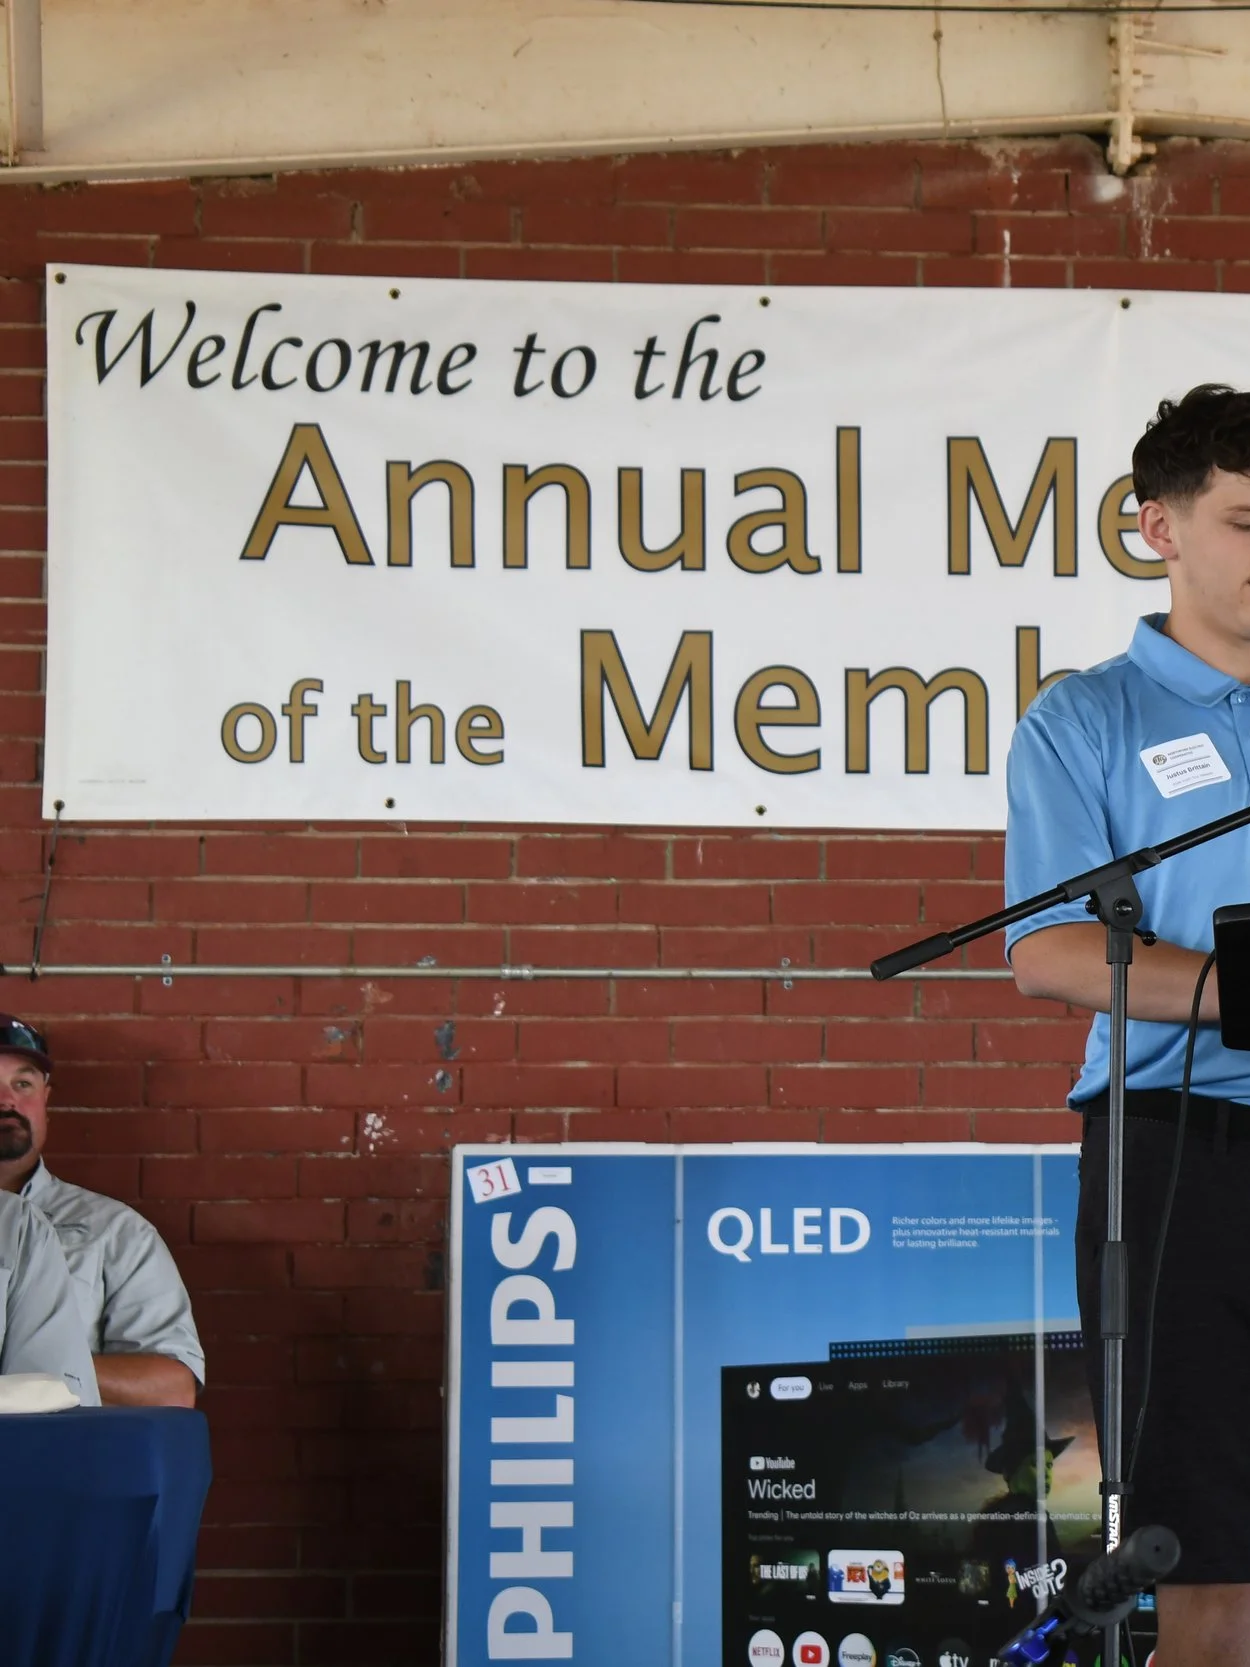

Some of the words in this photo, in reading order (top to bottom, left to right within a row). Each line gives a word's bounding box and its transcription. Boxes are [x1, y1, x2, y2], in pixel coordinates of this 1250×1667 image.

[75, 300, 478, 397] Welcome
[513, 331, 597, 400] to
[633, 313, 767, 402] the
[238, 421, 863, 576] Annual
[220, 677, 325, 766] of
[350, 680, 506, 768] the
[477, 1163, 511, 1197] 31
[892, 1216, 919, 1225] Richer
[921, 1216, 947, 1225] colors
[948, 1216, 966, 1225] and
[967, 1217, 990, 1225] more
[991, 1216, 1020, 1225] lifelike
[707, 1205, 872, 1263] QLED
[892, 1227, 911, 1237] plus
[912, 1227, 958, 1236] innovative
[959, 1227, 1018, 1236] heat-resistant
[1019, 1227, 1060, 1236] materials
[892, 1239, 906, 1248] for
[907, 1239, 937, 1249] lasting
[778, 1383, 790, 1392] For
[791, 1385, 805, 1393] you
[819, 1382, 834, 1391] Live
[848, 1381, 869, 1391] Apps
[882, 1379, 910, 1391] Library
[487, 1206, 577, 1661] PHILIPS
[765, 1456, 796, 1470] YouTube
[747, 1478, 816, 1500] Wicked
[747, 1510, 779, 1521] Trending
[786, 1511, 799, 1520] The
[800, 1511, 824, 1520] untold
[824, 1511, 844, 1521] story
[845, 1511, 853, 1520] of
[854, 1511, 867, 1520] the
[868, 1511, 898, 1520] witches
[899, 1511, 907, 1520] of
[908, 1511, 920, 1520] Oz
[921, 1511, 948, 1520] arrives
[950, 1511, 959, 1520] as
[1049, 1511, 1090, 1521] cinematic
[760, 1564, 772, 1580] THE
[772, 1564, 789, 1580] LAST
[790, 1564, 798, 1580] OF
[752, 1646, 781, 1658] NETFLIX
[842, 1650, 873, 1662] Freeplay
